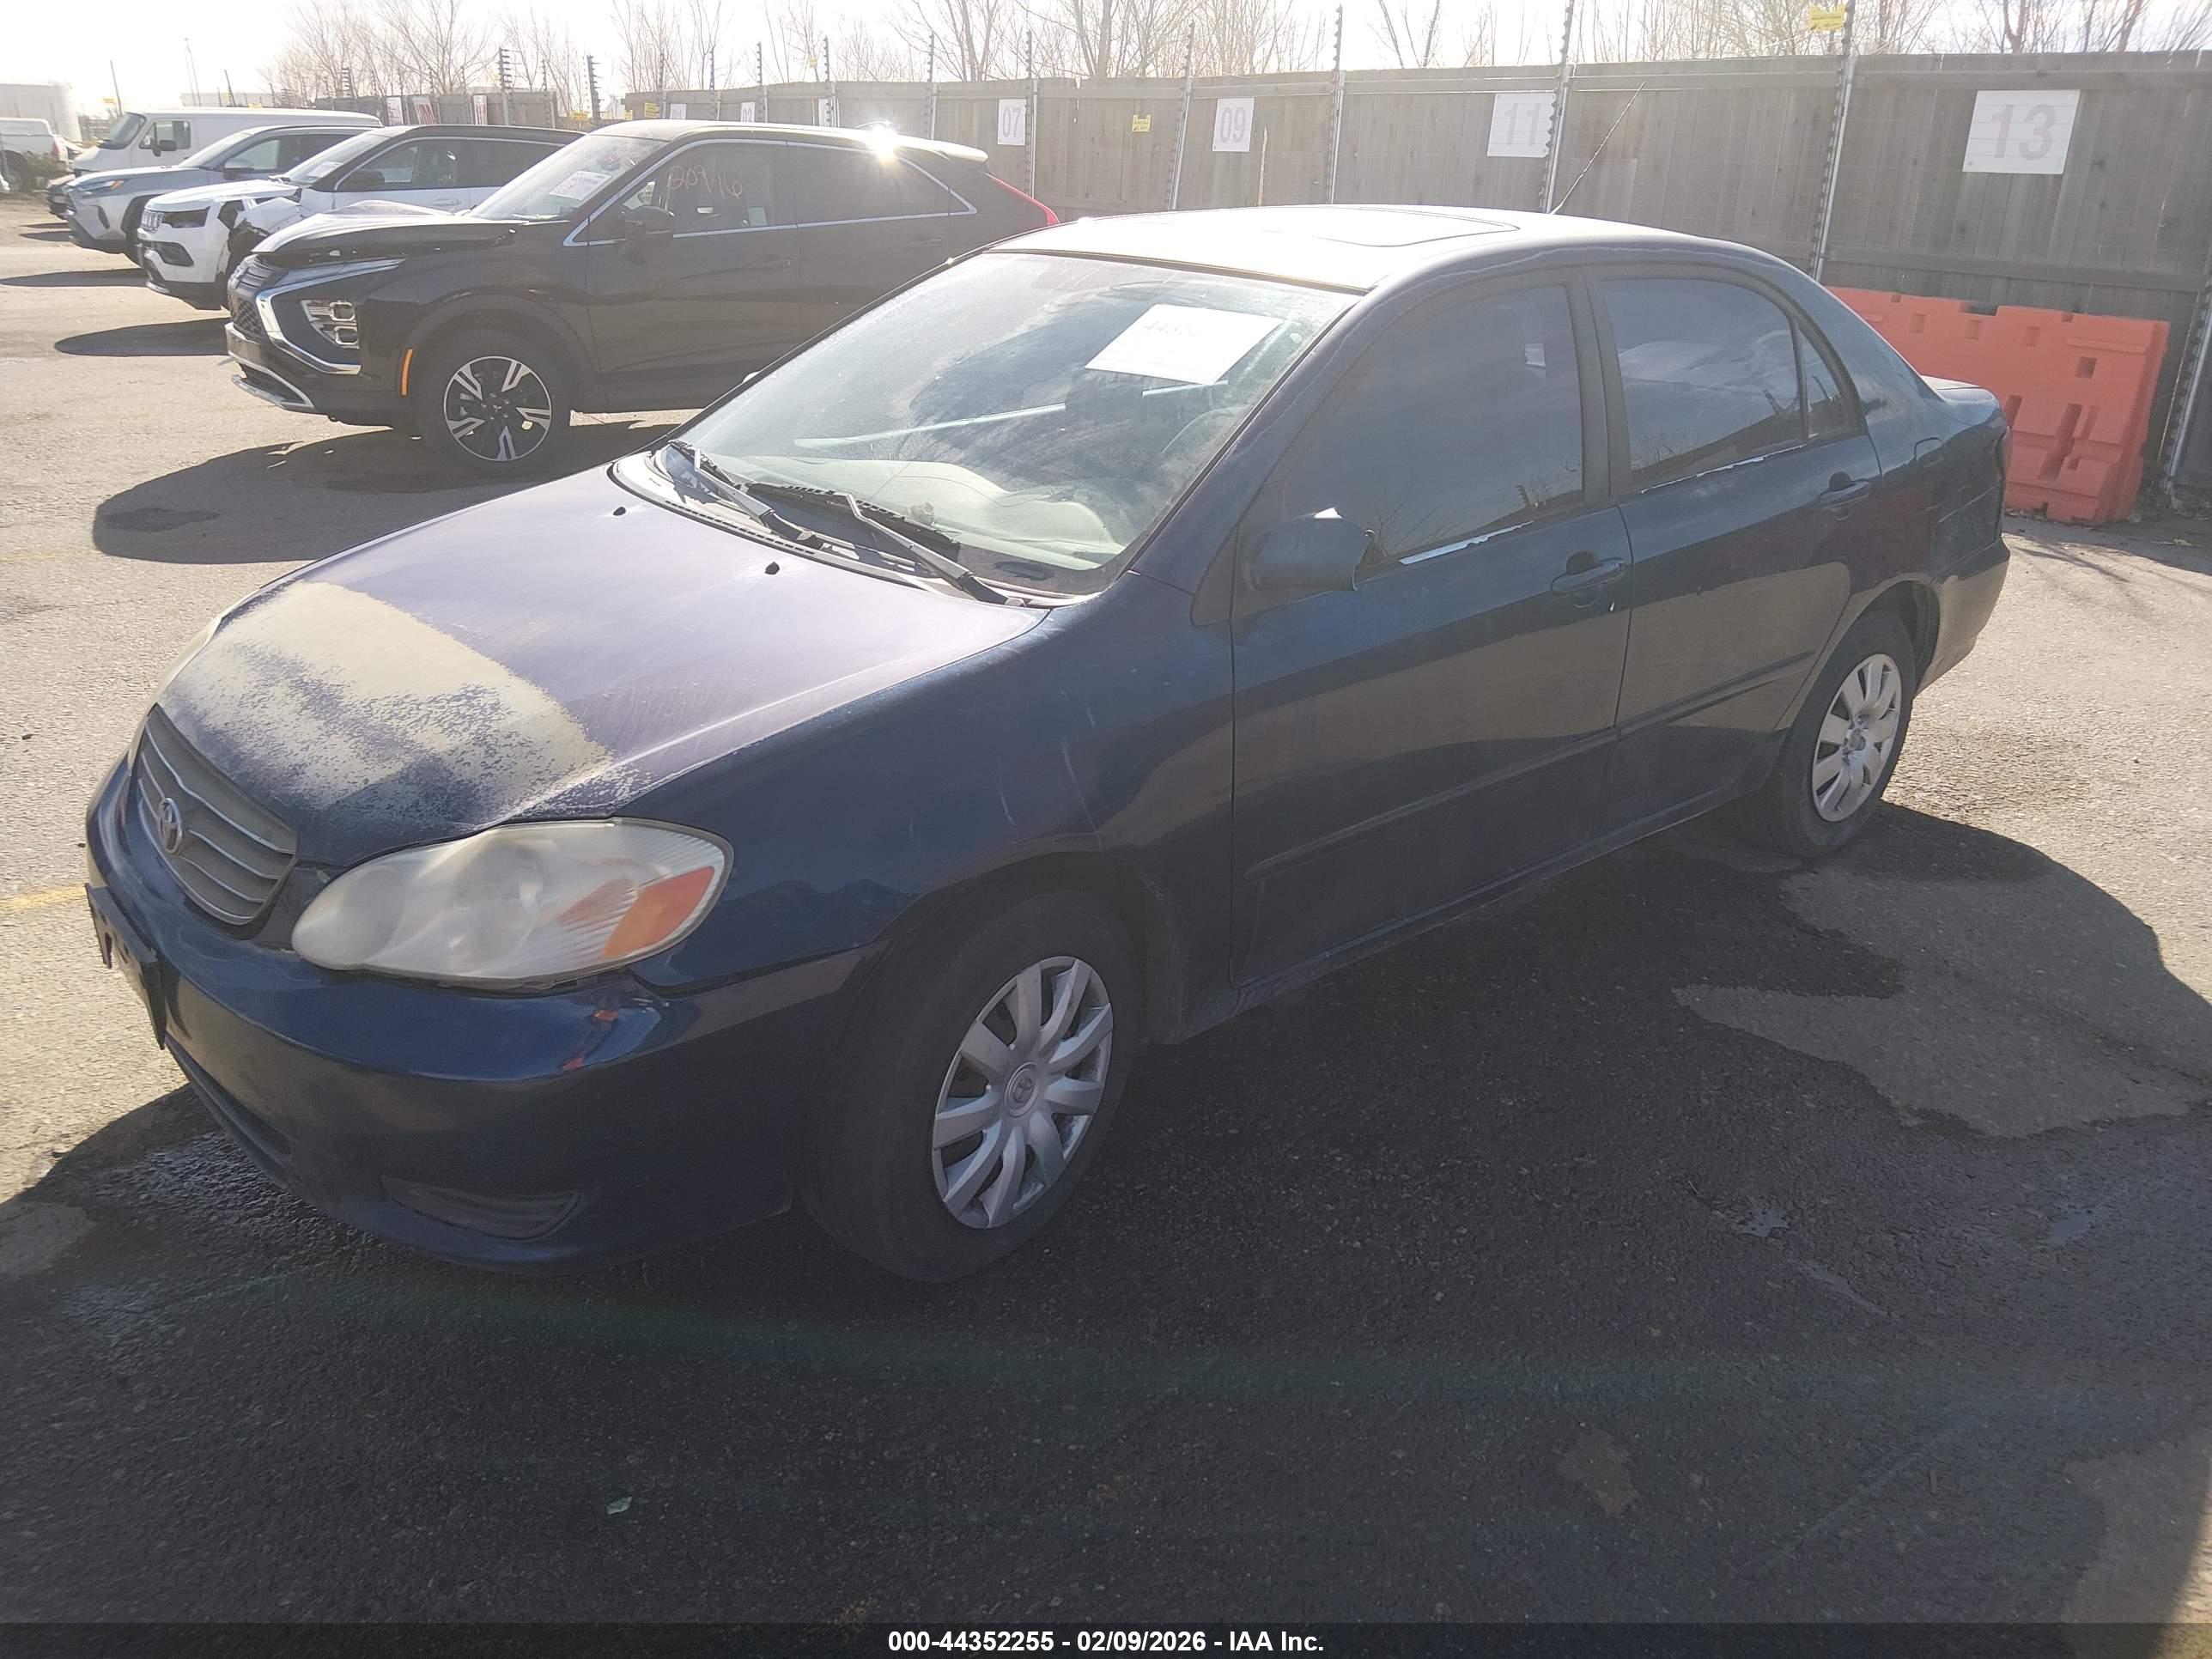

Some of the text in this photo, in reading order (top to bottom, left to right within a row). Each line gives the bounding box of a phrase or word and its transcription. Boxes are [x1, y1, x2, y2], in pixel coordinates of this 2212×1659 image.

[1002, 106, 1022, 138] 07
[1219, 106, 1246, 143] 09
[1504, 102, 1540, 146] 11
[1991, 104, 2056, 161] 13
